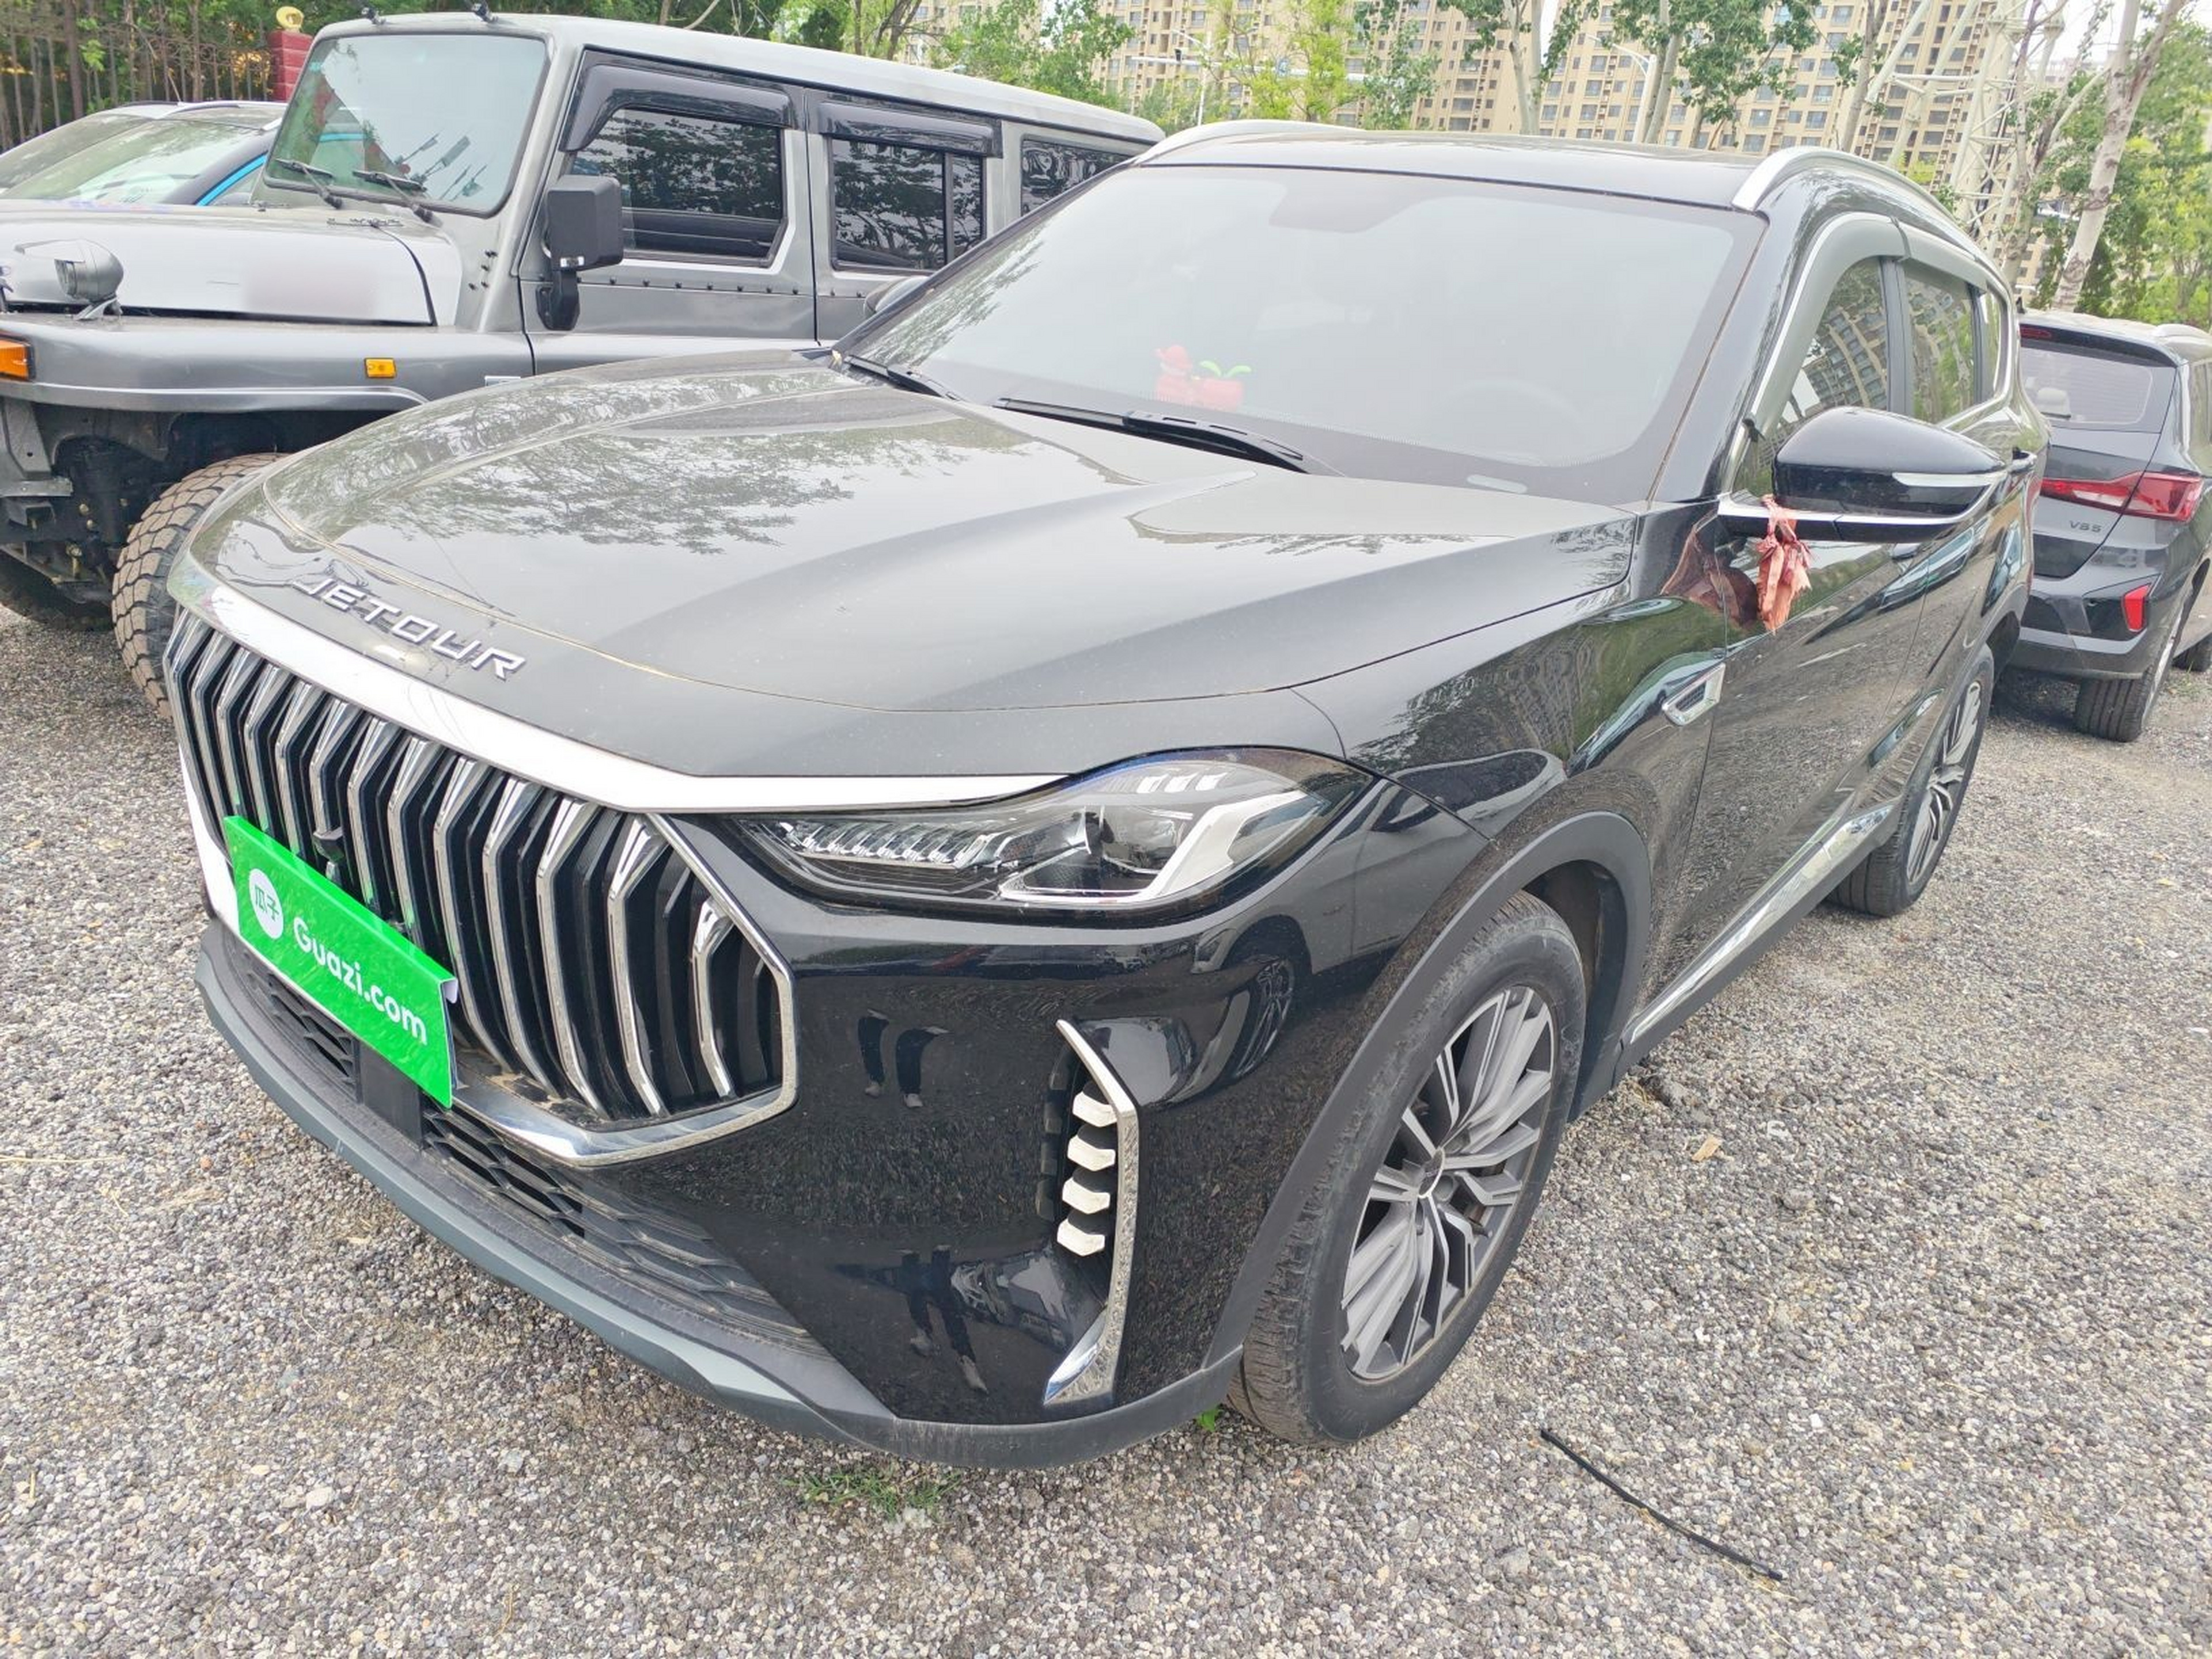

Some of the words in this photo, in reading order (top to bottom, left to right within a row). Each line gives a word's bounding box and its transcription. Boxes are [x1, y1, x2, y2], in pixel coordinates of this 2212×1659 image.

[292, 578, 527, 682] JETOUR
[254, 884, 279, 922] 瓜子
[293, 916, 428, 1046] Guazi.com
